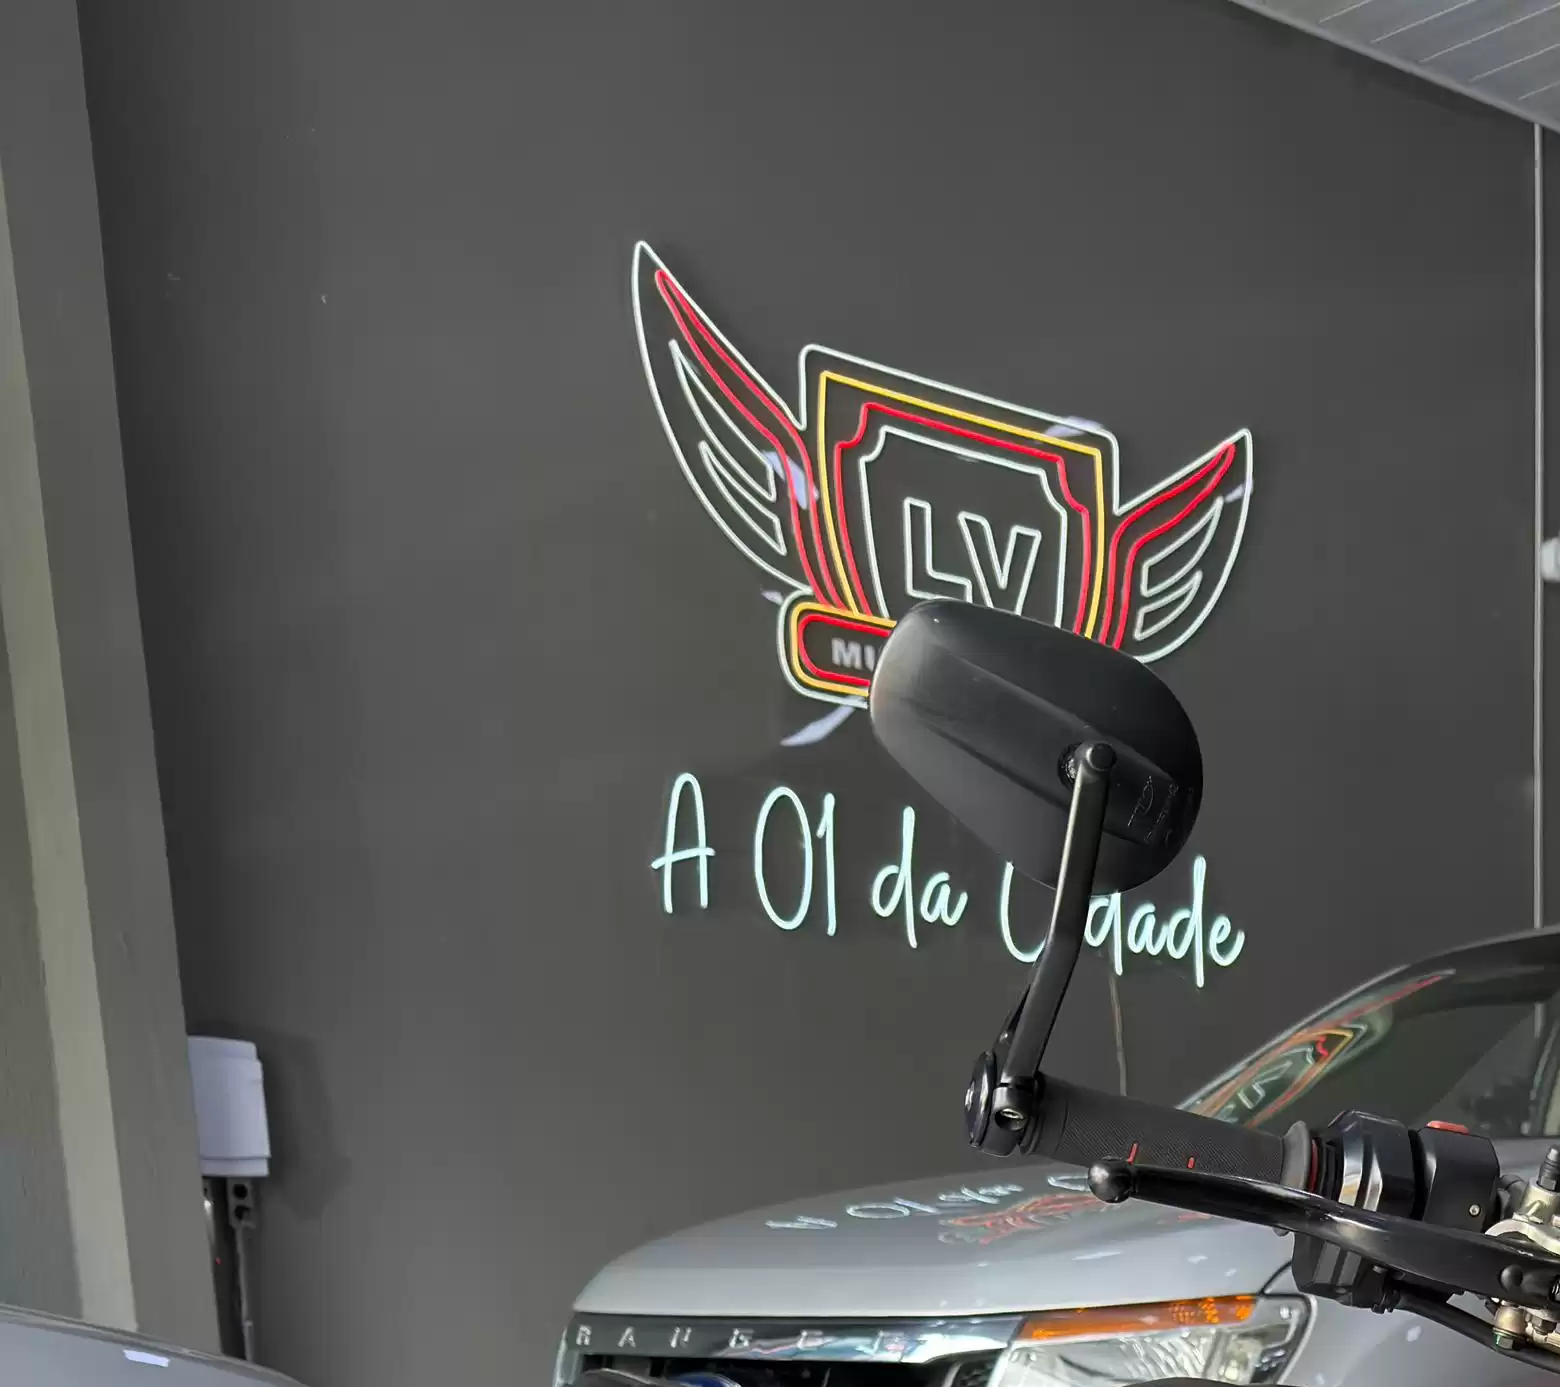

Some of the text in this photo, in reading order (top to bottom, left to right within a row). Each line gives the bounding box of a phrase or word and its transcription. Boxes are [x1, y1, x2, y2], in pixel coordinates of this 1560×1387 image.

[904, 497, 1042, 615] LV
[651, 773, 715, 913] A
[871, 806, 967, 948] da
